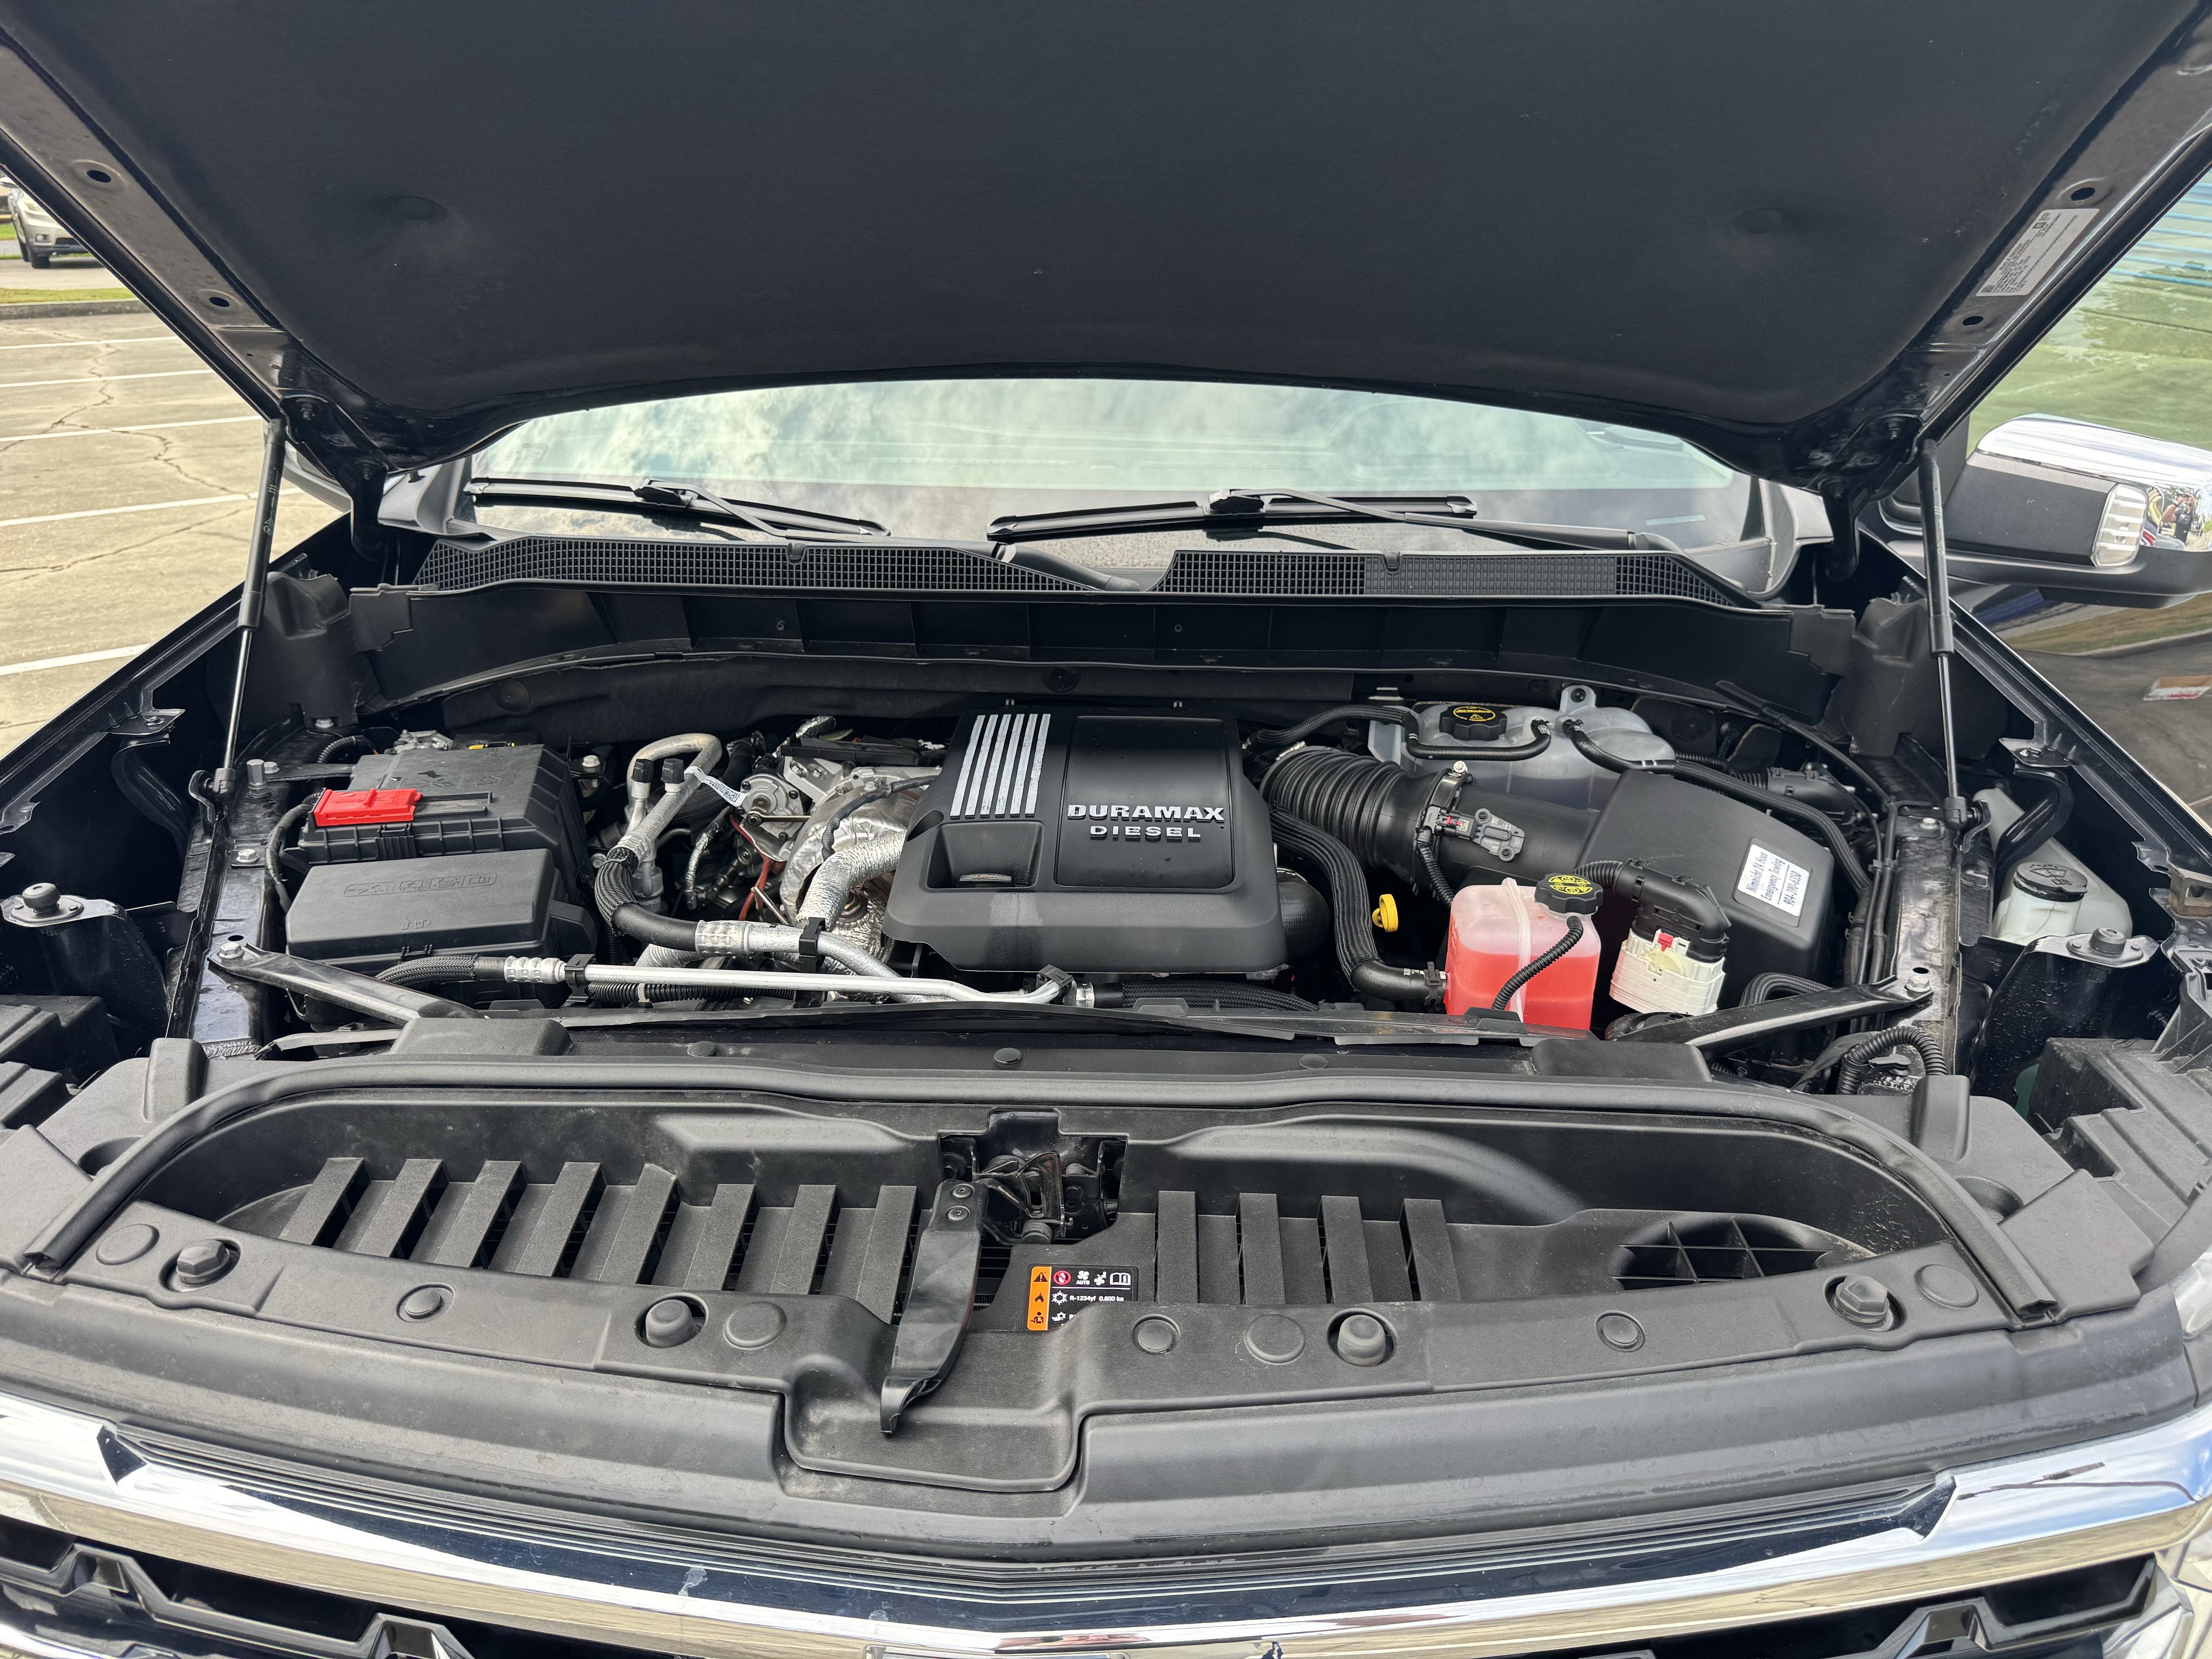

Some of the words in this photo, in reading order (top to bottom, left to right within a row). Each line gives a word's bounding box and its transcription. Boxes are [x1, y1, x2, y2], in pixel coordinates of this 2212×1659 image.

[1067, 804, 1225, 823] DURAMAX
[1090, 826, 1201, 840] DIESEL
[1753, 862, 1765, 871] 24
[1755, 852, 1768, 865] Hour
[1768, 858, 1786, 875] Towing
[1745, 869, 1762, 893] Nimnicht
[1760, 874, 1781, 901] Emergency
[1783, 871, 1802, 906] 904-390-6350
